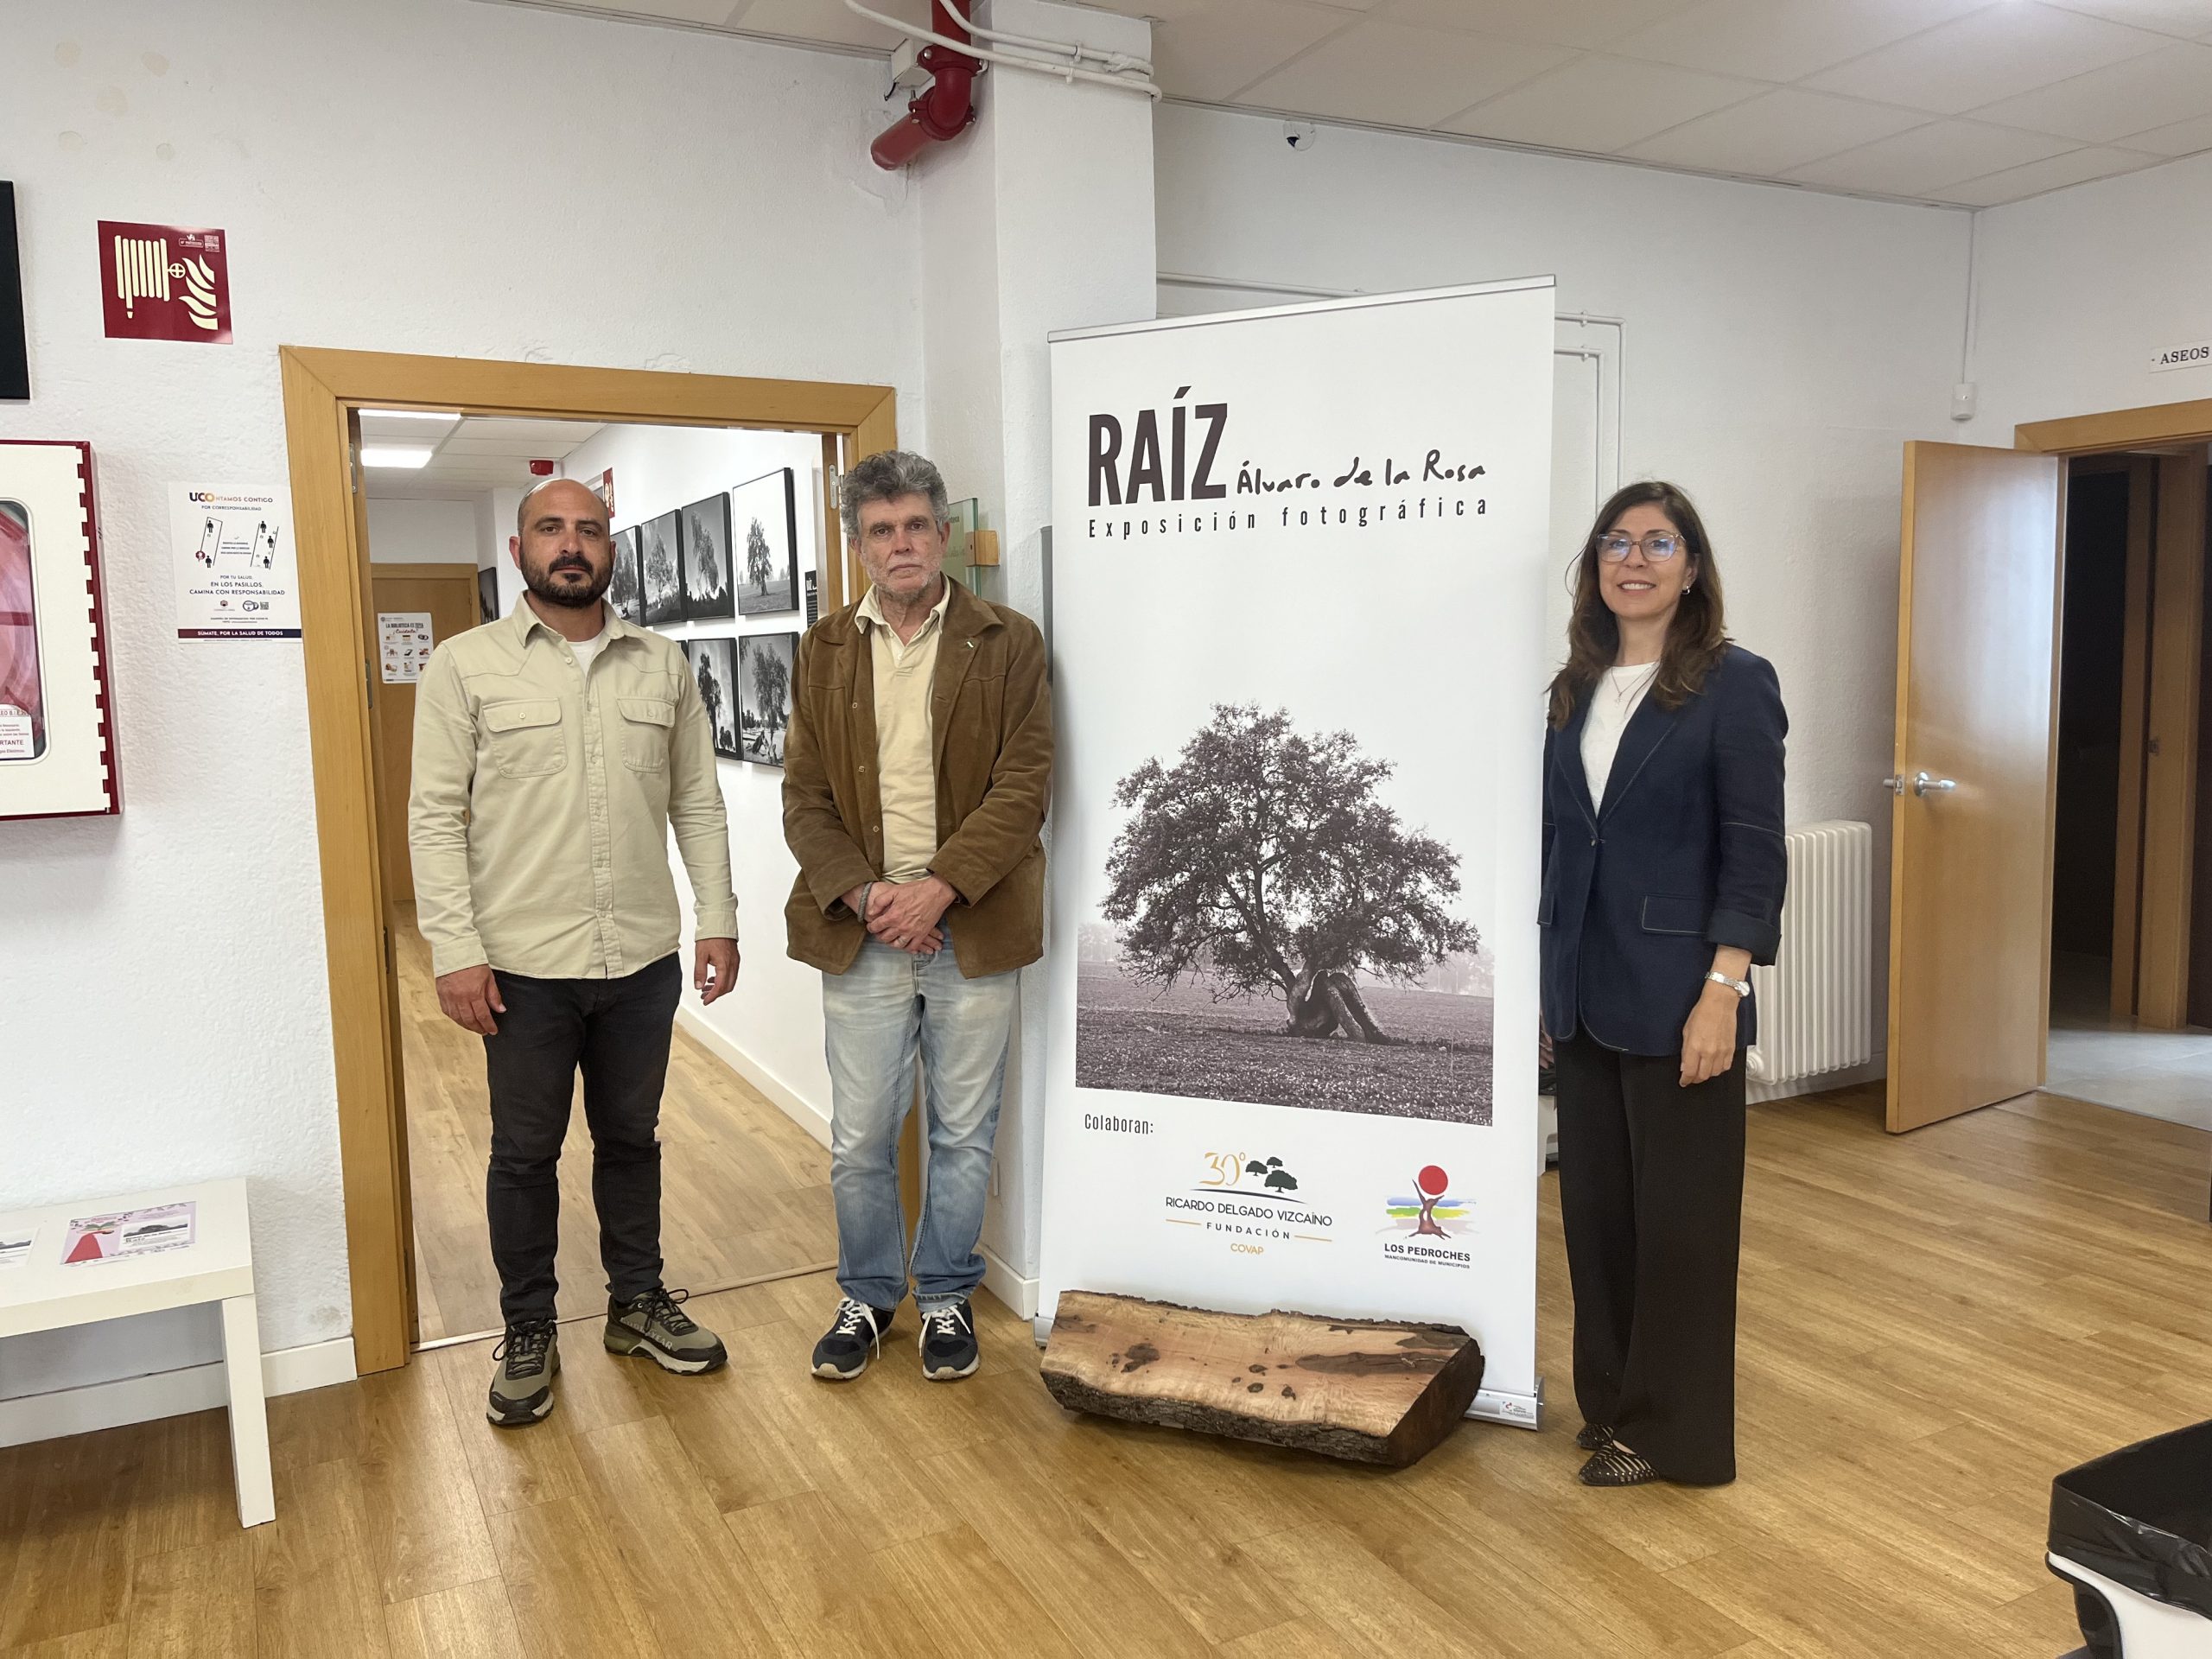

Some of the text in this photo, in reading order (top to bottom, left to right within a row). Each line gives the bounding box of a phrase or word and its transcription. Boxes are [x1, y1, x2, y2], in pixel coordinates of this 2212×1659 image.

[2160, 346, 2209, 365] ASEOS
[1088, 385, 1486, 506] RAÍZ Álvaro de la Rosa
[1089, 498, 1486, 539] Exposición fotográfica
[1084, 1114, 1154, 1135] Colaboran:
[1166, 1197, 1333, 1227] RICARDO DELGADO VIZCAÍNO
[1206, 1222, 1290, 1240] FUNDACIÓN
[1230, 1243, 1264, 1255] COVAP
[1384, 1243, 1471, 1262] LOS PEDROCHES
[1384, 1255, 1428, 1264] MANCOMUNIDAD
[1438, 1261, 1471, 1269] MUNICIPIOS
